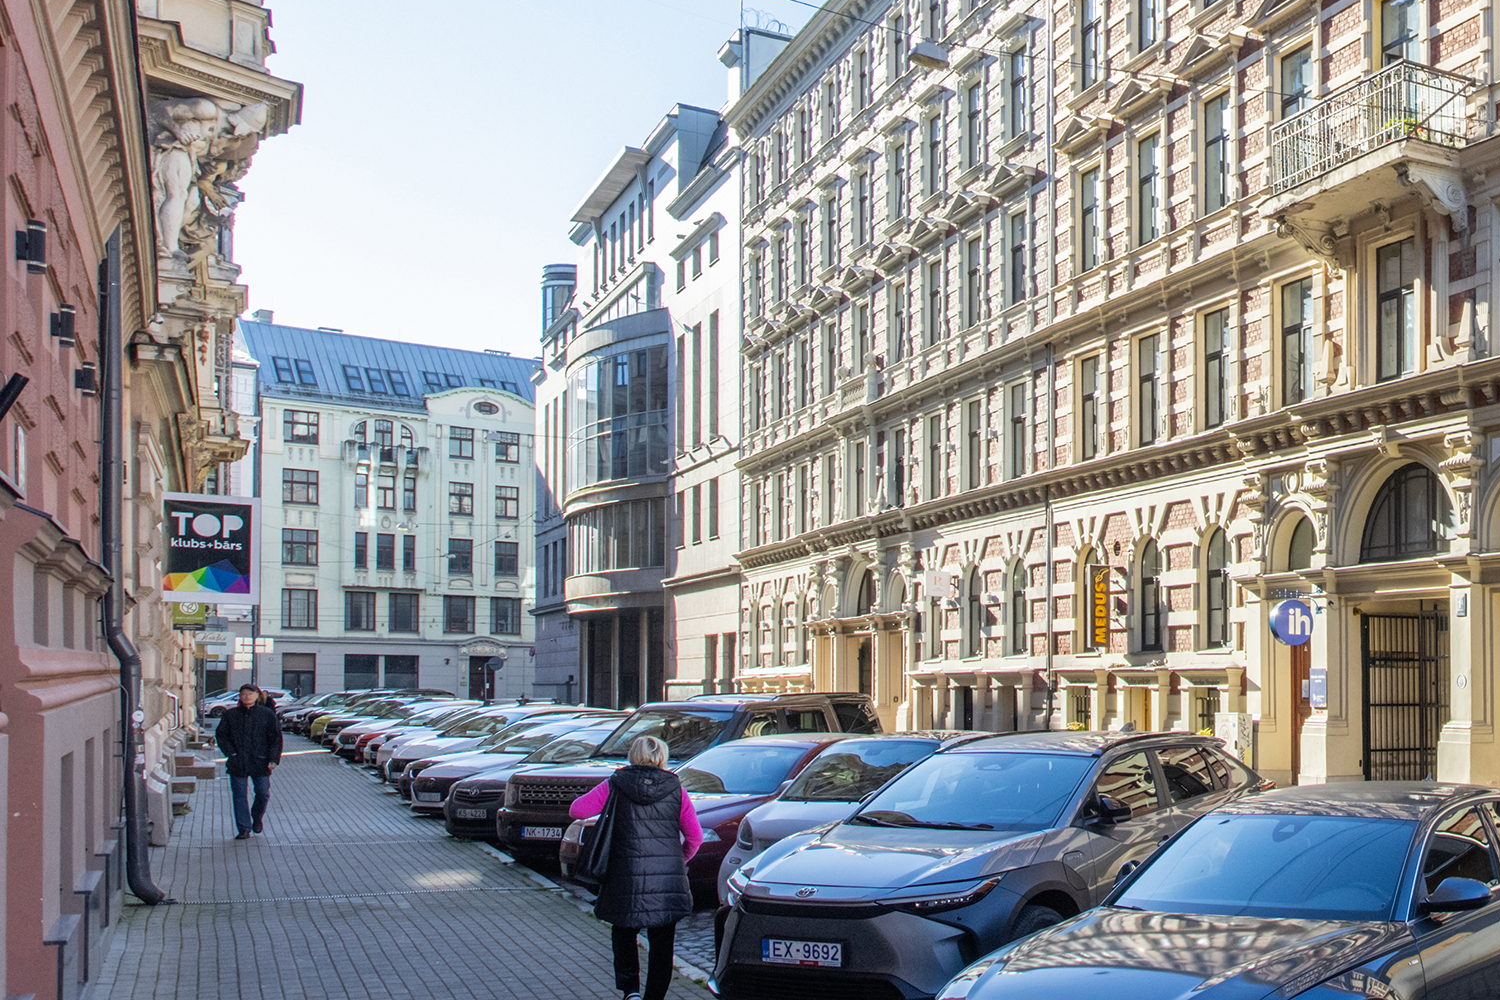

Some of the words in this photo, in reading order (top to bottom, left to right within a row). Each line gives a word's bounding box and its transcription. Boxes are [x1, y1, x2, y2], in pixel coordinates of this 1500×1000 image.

[171, 511, 244, 538] TOP
[170, 537, 243, 551] klubs+bārs
[1094, 582, 1107, 644] MEDUS
[1288, 608, 1311, 636] ih
[525, 827, 561, 838] NK-1734
[772, 941, 840, 961] EX-9692
